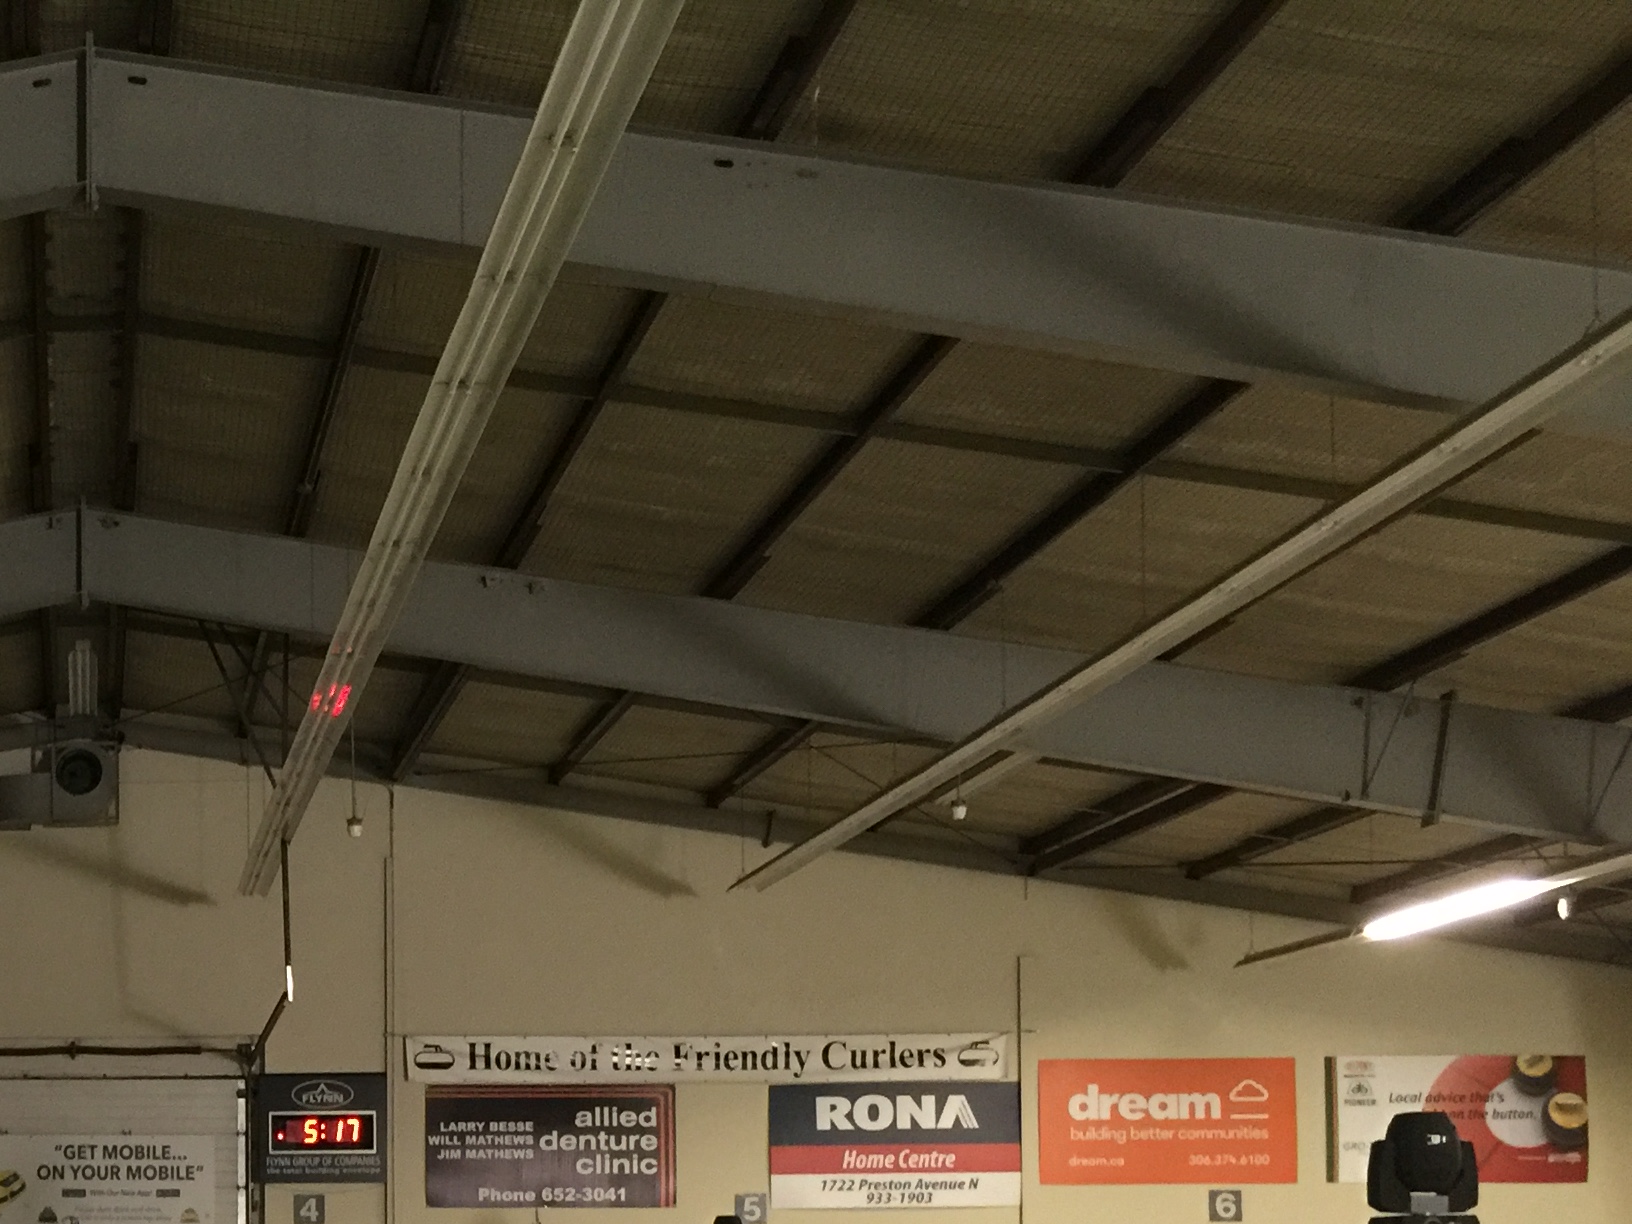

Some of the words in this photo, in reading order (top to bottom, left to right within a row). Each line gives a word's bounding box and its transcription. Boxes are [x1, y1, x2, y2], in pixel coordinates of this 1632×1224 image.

[468, 1043, 559, 1072] Home
[569, 1043, 599, 1070] of
[611, 1043, 658, 1072] the
[673, 1042, 808, 1078] Friendly
[822, 1040, 946, 1070] Curlers
[302, 1092, 344, 1103] FLYNN
[1068, 1084, 1221, 1121] dream
[1388, 1092, 1421, 1104] Local
[1425, 1092, 1466, 1104] advice
[574, 1106, 657, 1127] allied
[815, 1094, 979, 1131] RONA
[304, 1118, 360, 1143] 5:17
[440, 1121, 484, 1132] LARRY
[489, 1121, 534, 1132] BESSE
[1069, 1126, 1126, 1144] building
[1130, 1126, 1174, 1140] better
[1178, 1125, 1269, 1140] communities
[428, 1135, 461, 1146] WILL
[465, 1134, 534, 1145] MATHEWS
[539, 1130, 658, 1151] denture
[54, 1144, 98, 1160] "GET
[103, 1144, 188, 1161] MOBILE...
[437, 1148, 461, 1159] JIM
[465, 1149, 534, 1159] MATHEWS
[842, 1150, 894, 1169] Home
[898, 1149, 956, 1168] Centre
[1068, 1154, 1125, 1167] dream.ca
[37, 1164, 65, 1180] ON
[70, 1164, 120, 1180] YOUR
[126, 1164, 204, 1181] MOBILE"
[576, 1154, 658, 1175] clinic
[821, 1179, 854, 1191] 1722
[858, 1179, 912, 1191] Preston
[915, 1179, 965, 1190] Avenue
[969, 1178, 979, 1189] N
[478, 1187, 536, 1202] Phone
[541, 1187, 626, 1202] 652-3041
[866, 1193, 933, 1204] 933-1903
[299, 1197, 319, 1222] 4
[743, 1197, 761, 1221] 5
[1215, 1193, 1236, 1219] 6
